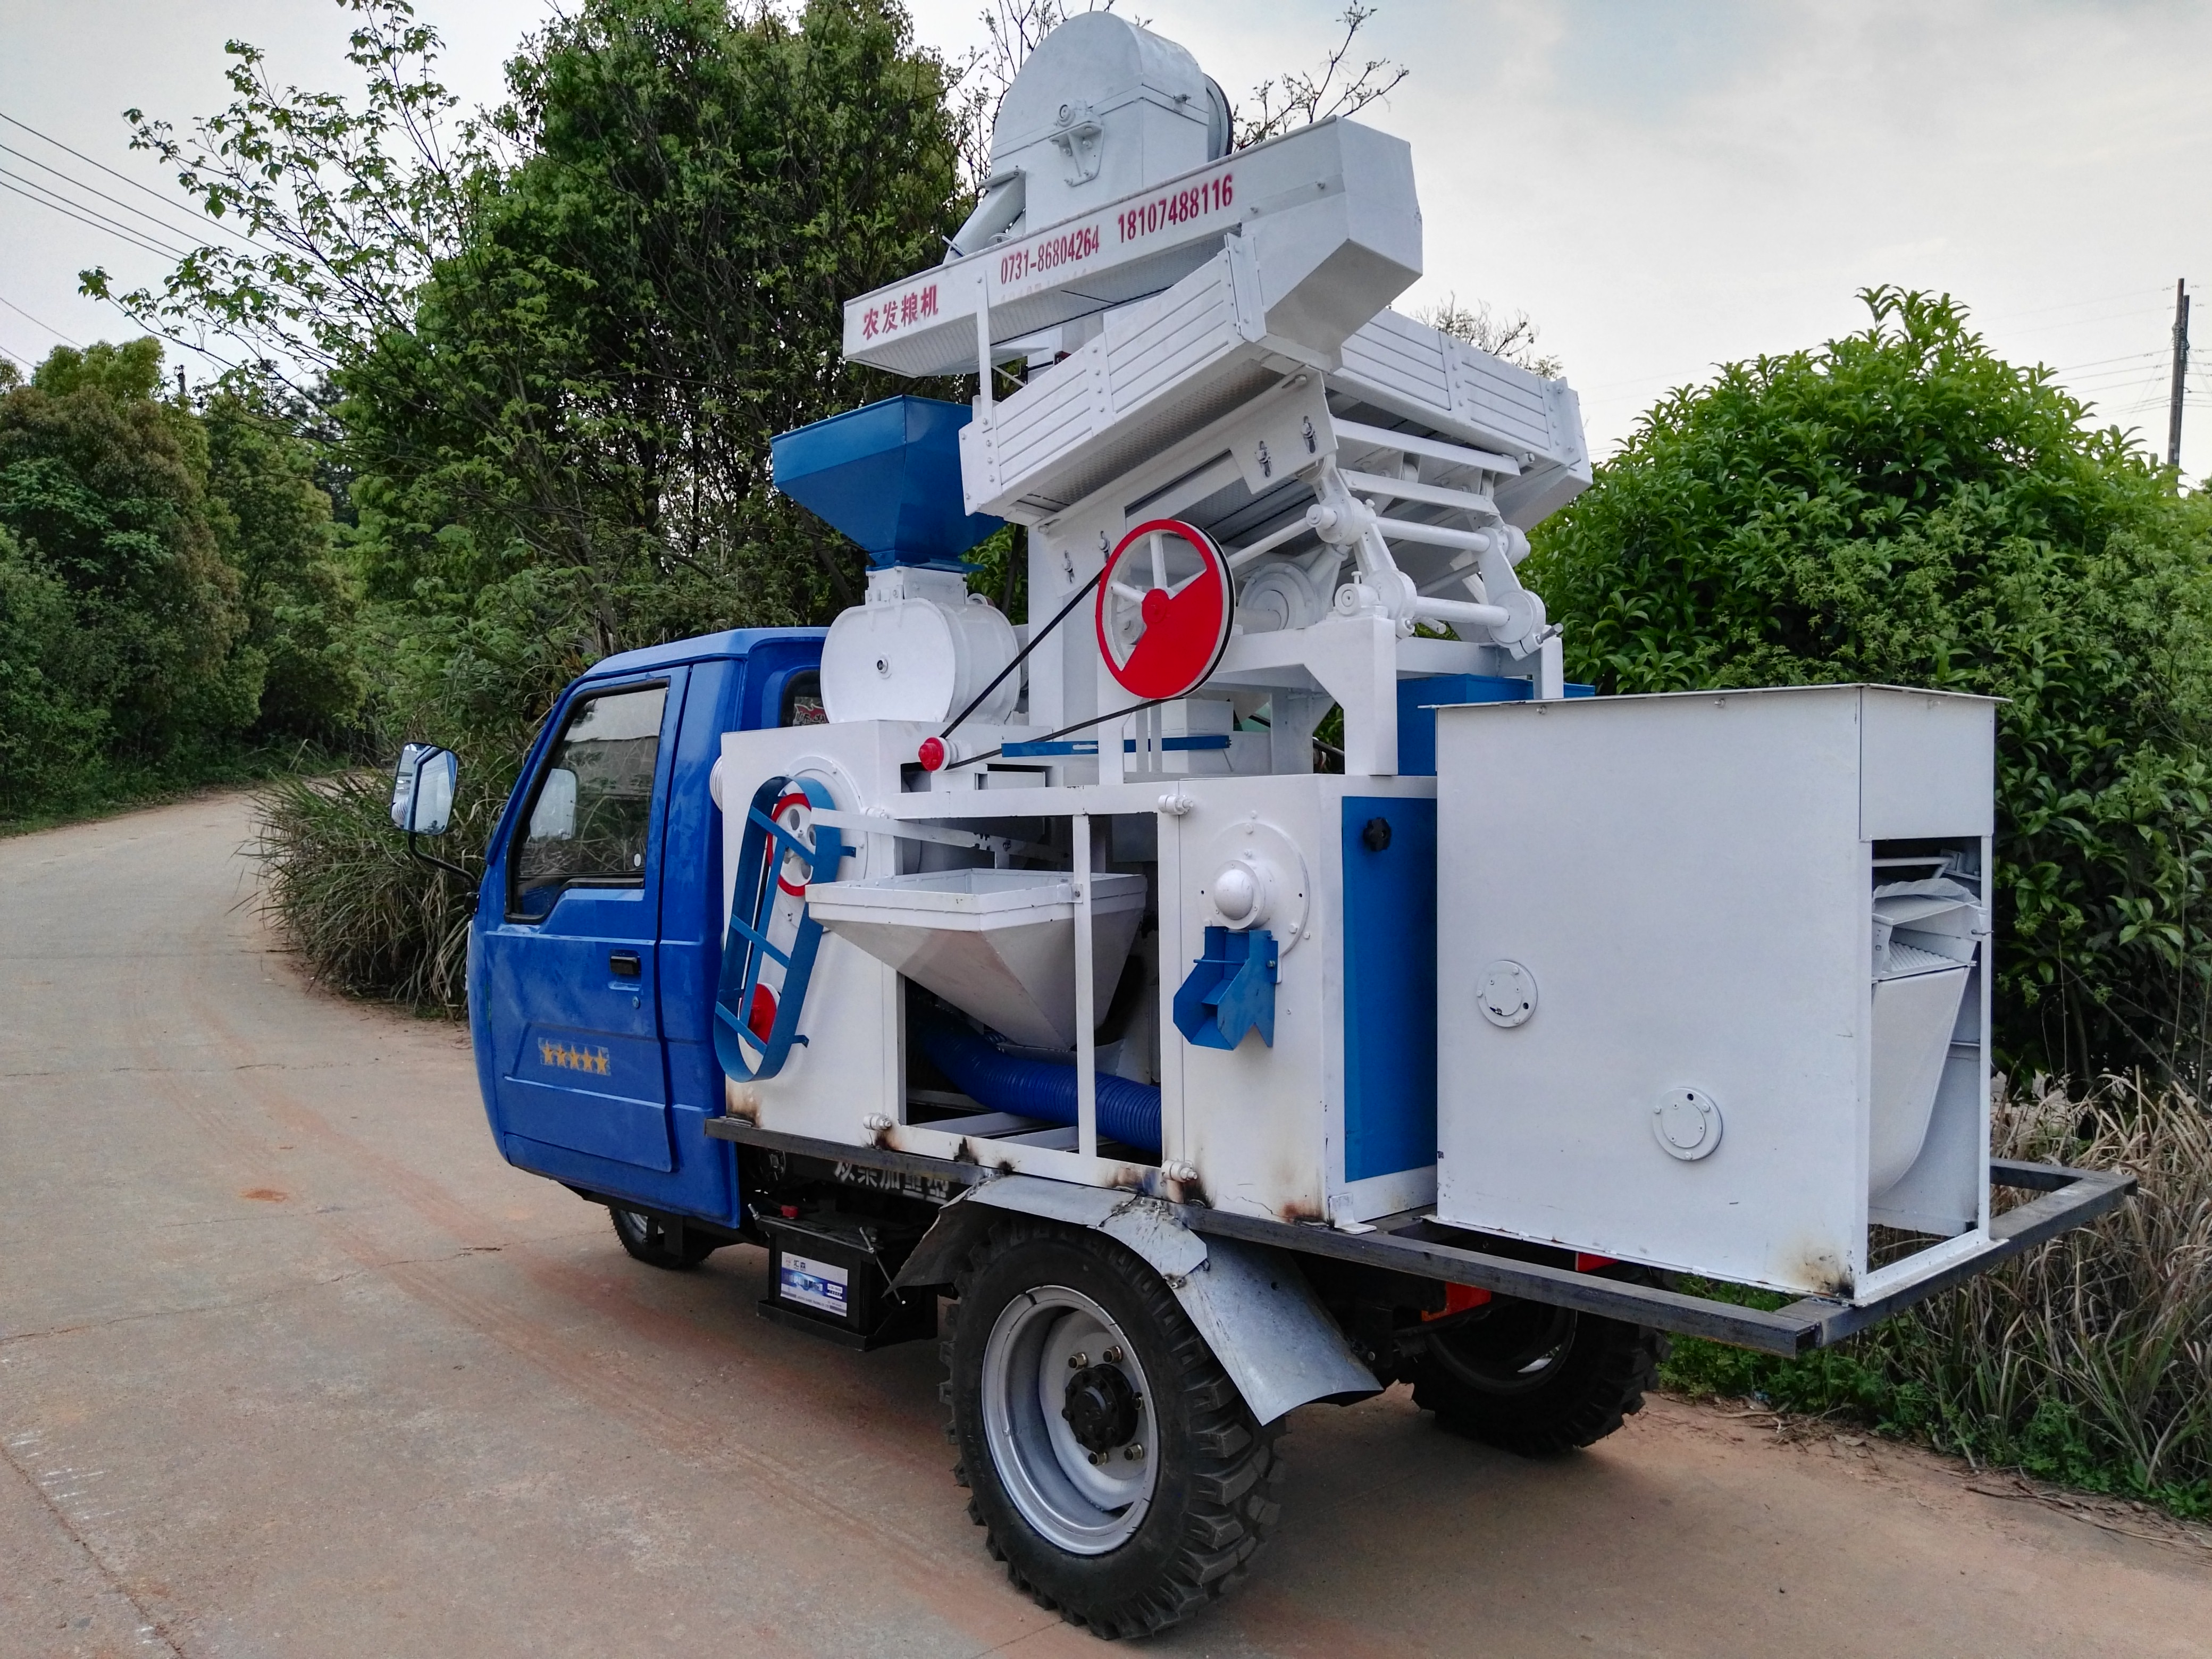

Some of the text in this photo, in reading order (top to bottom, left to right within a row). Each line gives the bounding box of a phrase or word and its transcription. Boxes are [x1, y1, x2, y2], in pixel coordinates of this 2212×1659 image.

[862, 284, 939, 341] 农发粮机
[1001, 224, 1100, 285] 0731-86804264
[1118, 173, 1233, 244] 18107488116
